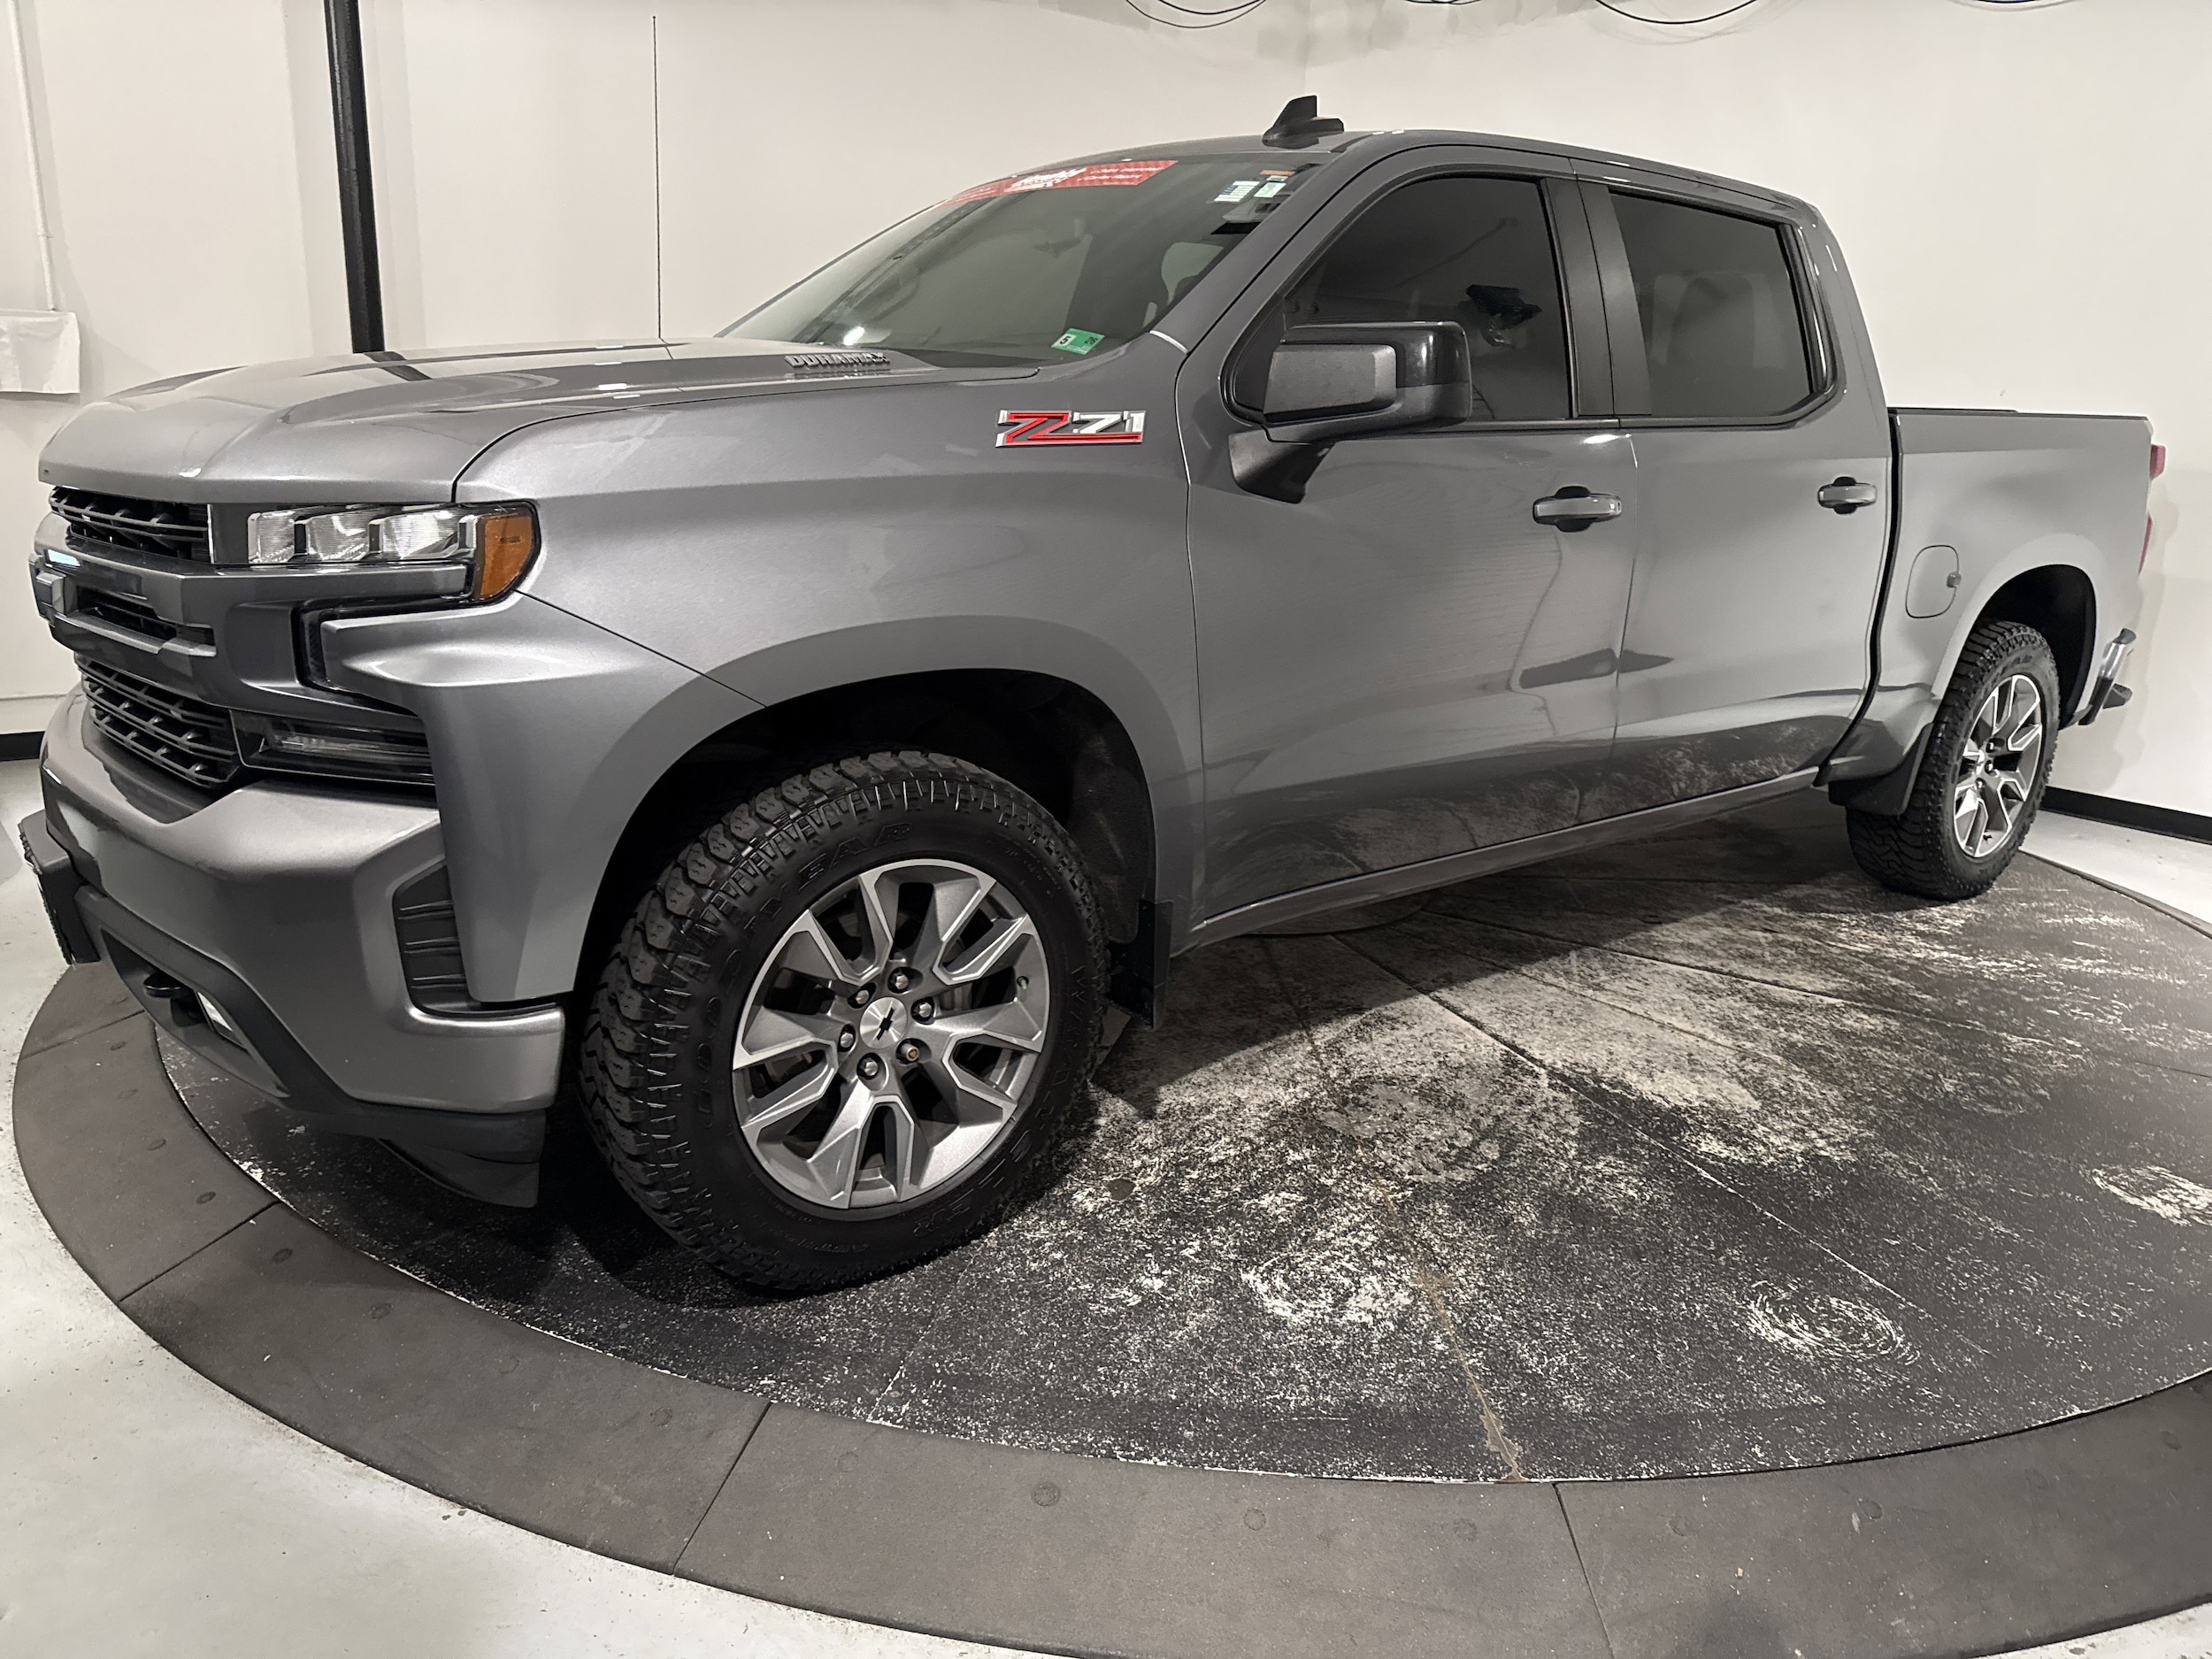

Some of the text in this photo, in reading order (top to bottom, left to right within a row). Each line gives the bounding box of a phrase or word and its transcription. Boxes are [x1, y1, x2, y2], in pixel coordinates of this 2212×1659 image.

[1059, 335, 1071, 345] 5
[784, 352, 890, 368] DURAMAX
[995, 410, 1147, 448] Z71
